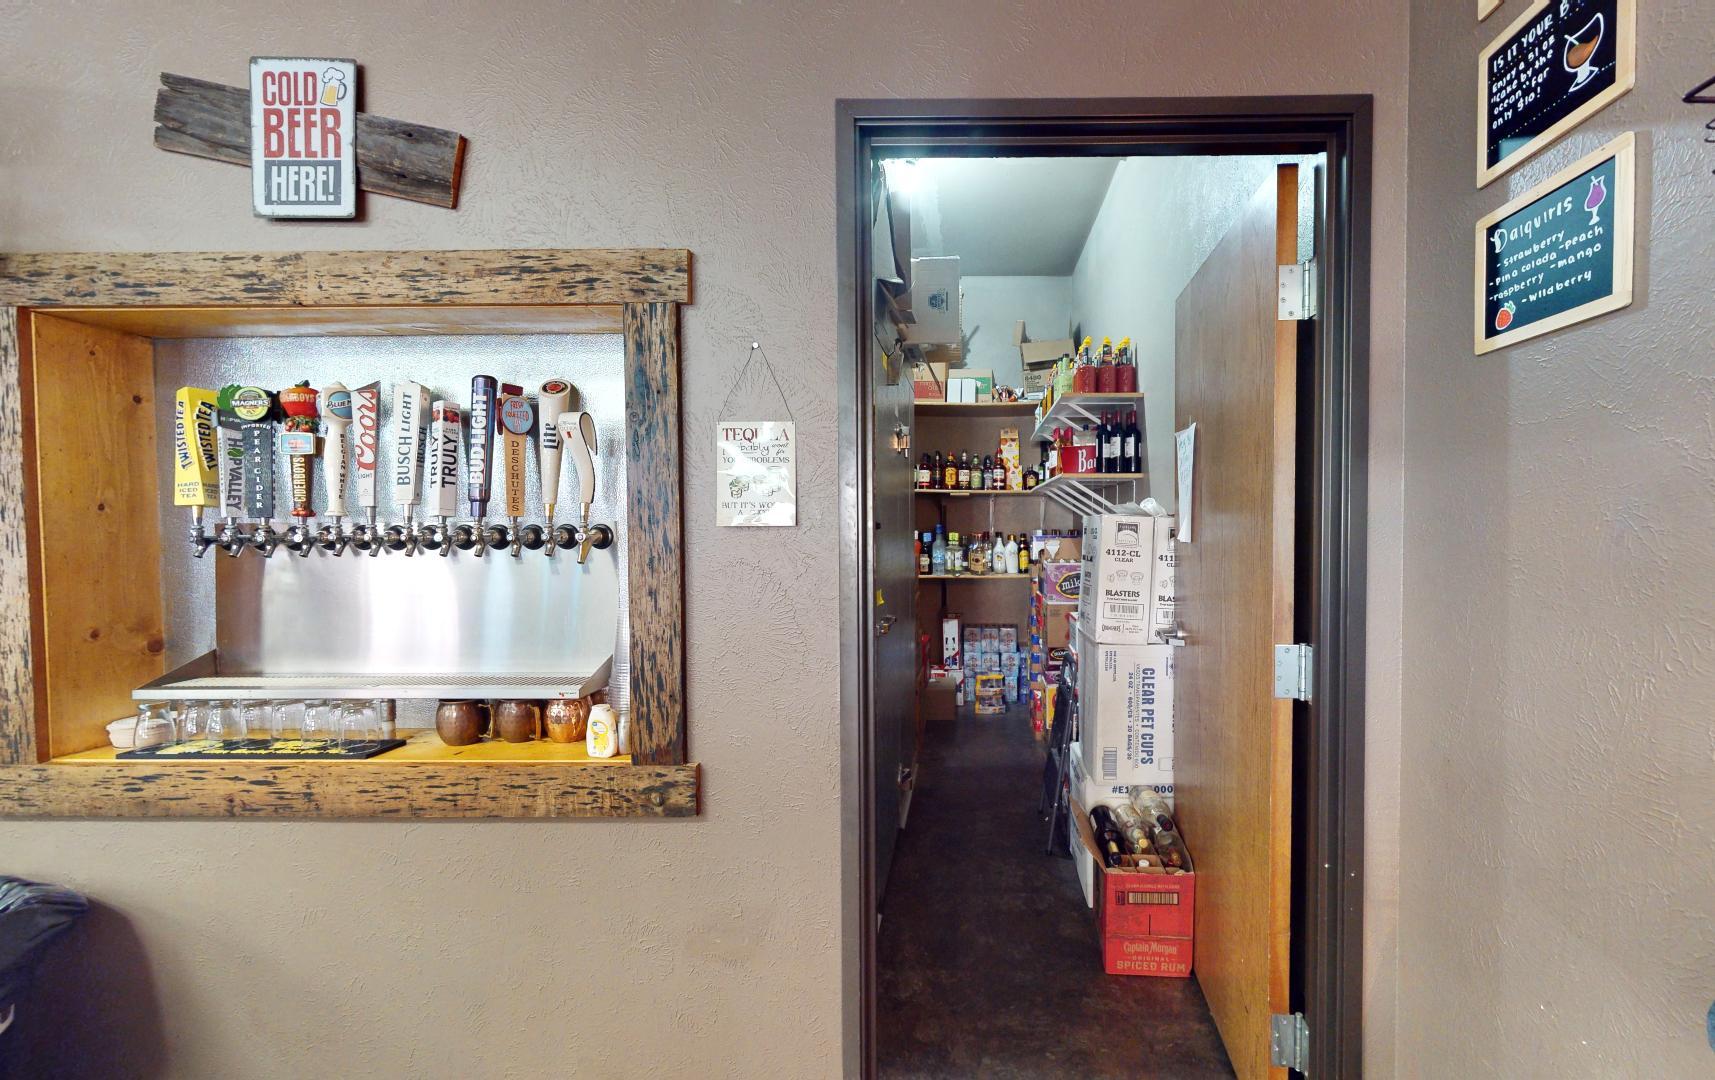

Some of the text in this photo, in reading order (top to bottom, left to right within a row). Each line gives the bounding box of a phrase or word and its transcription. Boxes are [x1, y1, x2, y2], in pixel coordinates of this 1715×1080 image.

[1493, 13, 1553, 73] IS IT YOUR
[1519, 61, 1525, 71] a
[1520, 68, 1533, 83] by
[1534, 49, 1554, 70] the
[262, 70, 318, 106] COLD
[263, 107, 342, 159] BEER
[1492, 111, 1513, 130] only
[271, 165, 335, 202] HERE!
[1521, 251, 1558, 273] colada
[231, 399, 270, 407] MAGNERS
[326, 399, 347, 409] BLUE
[176, 400, 193, 470] TWISTED TEA
[196, 400, 218, 471] TWISTED TEA
[355, 388, 378, 471] Coors
[396, 391, 413, 486] BUSCH LIGHT
[469, 392, 488, 485] BUD LIGHT
[543, 422, 560, 450] Lite
[253, 430, 264, 510] PEAR CIDER
[292, 456, 306, 502] CIDERBOYS
[510, 440, 520, 512] DESCHUTES
[721, 501, 738, 509] BUT
[1105, 548, 1141, 558] 4112-CL
[1158, 554, 1175, 562] 411
[1061, 577, 1080, 591] mik
[1105, 589, 1140, 598] BLASTERS
[1140, 667, 1155, 765] CLEAR PET CUPS
[1123, 941, 1177, 955] Captain Morgan
[1116, 960, 1186, 972] SPICED RUM
